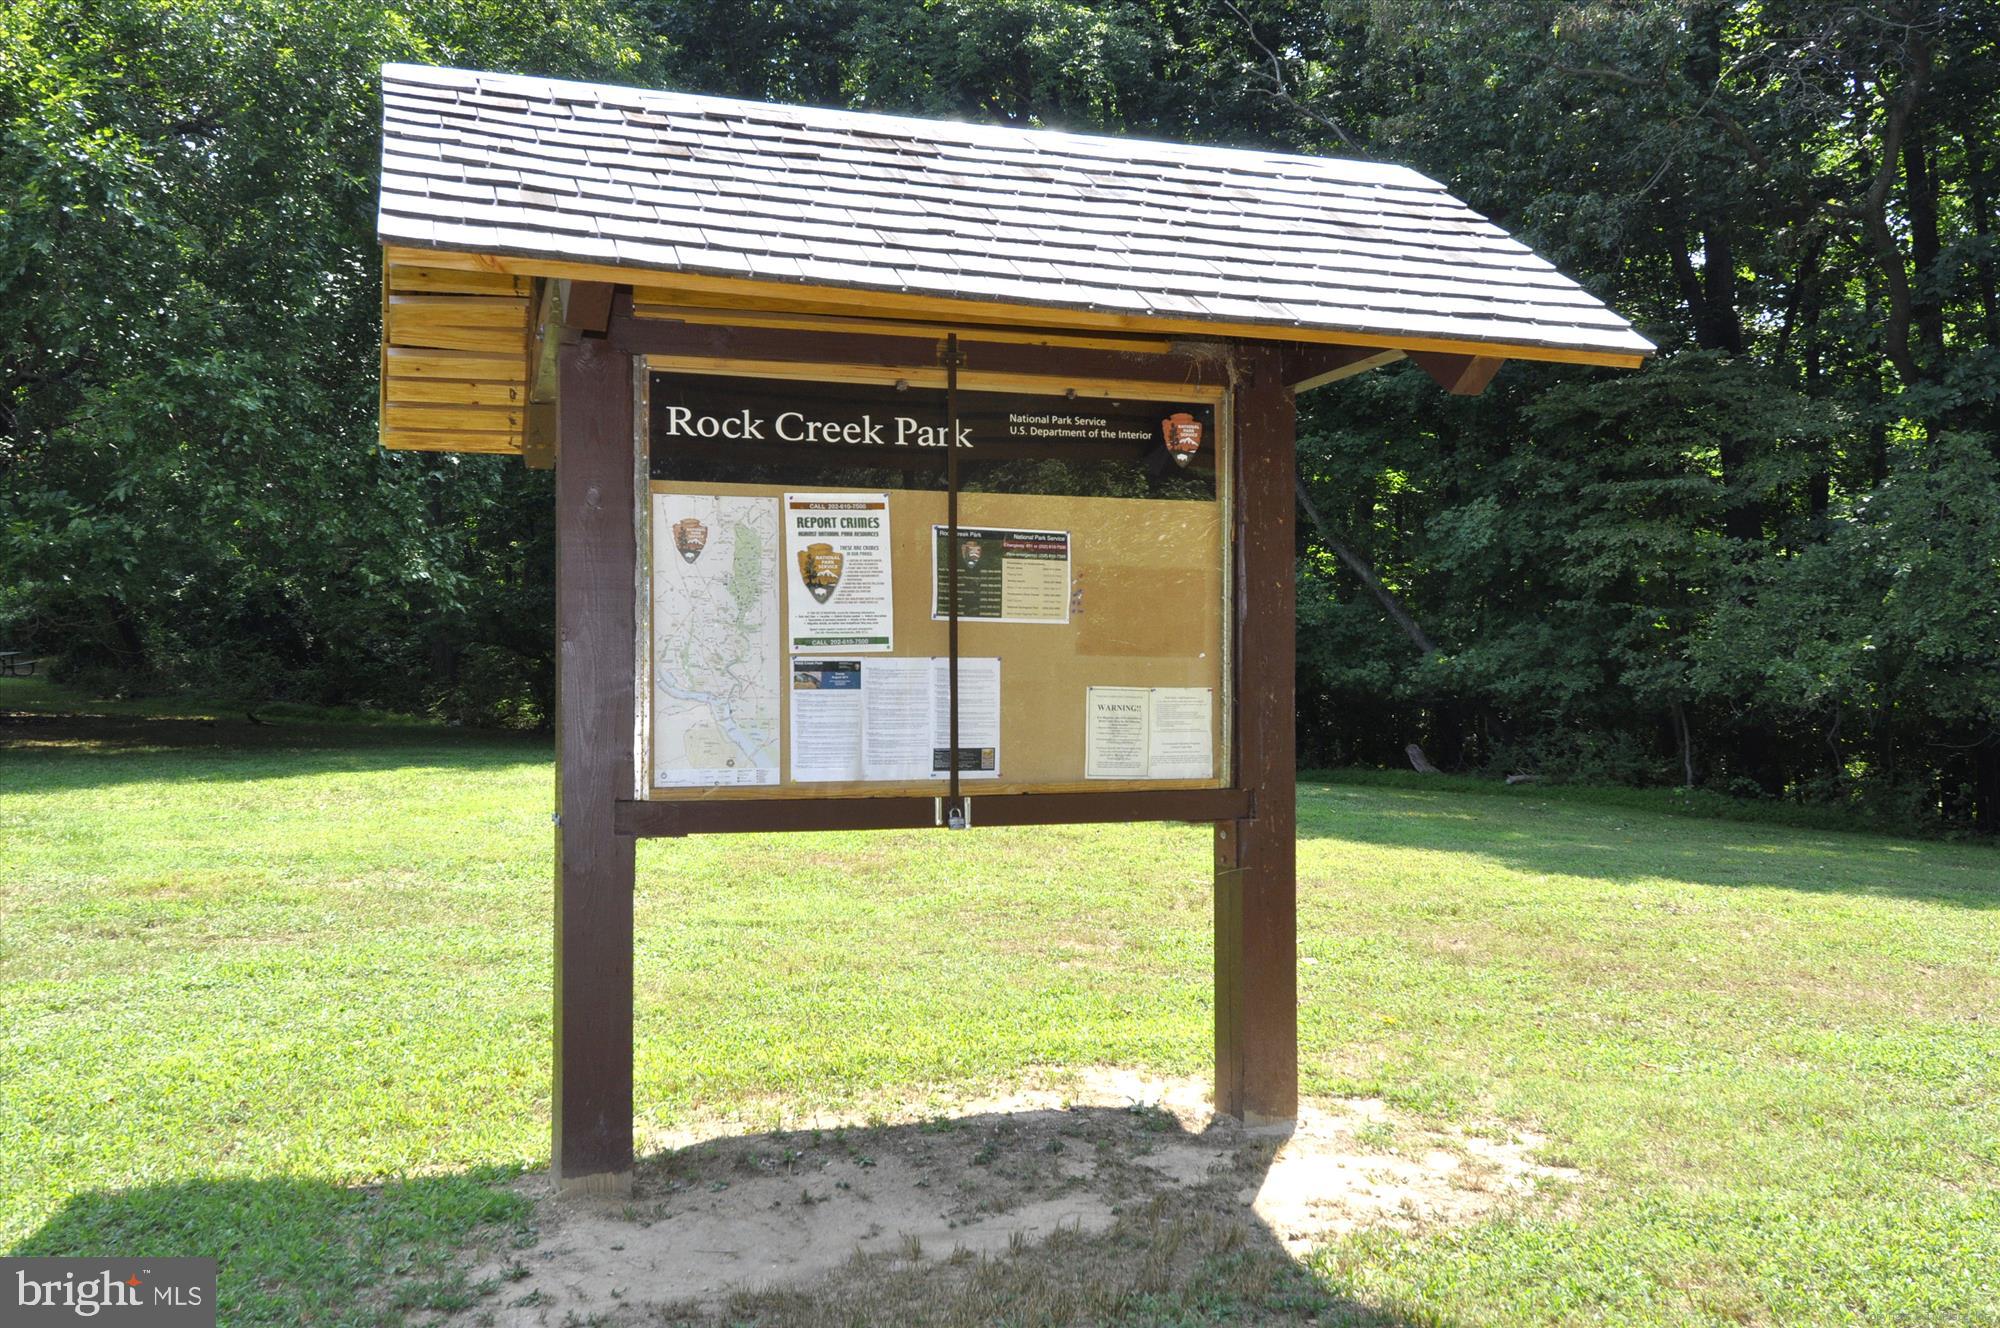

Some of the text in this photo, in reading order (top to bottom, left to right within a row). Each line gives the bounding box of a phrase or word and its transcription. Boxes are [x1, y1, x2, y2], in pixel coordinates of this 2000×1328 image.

[666, 406, 974, 448] Rock Creek Park
[1009, 414, 1107, 427] National Park Service
[1009, 426, 1152, 440] U.S. Department of the Interior
[796, 516, 880, 529] REPORT CRIMES
